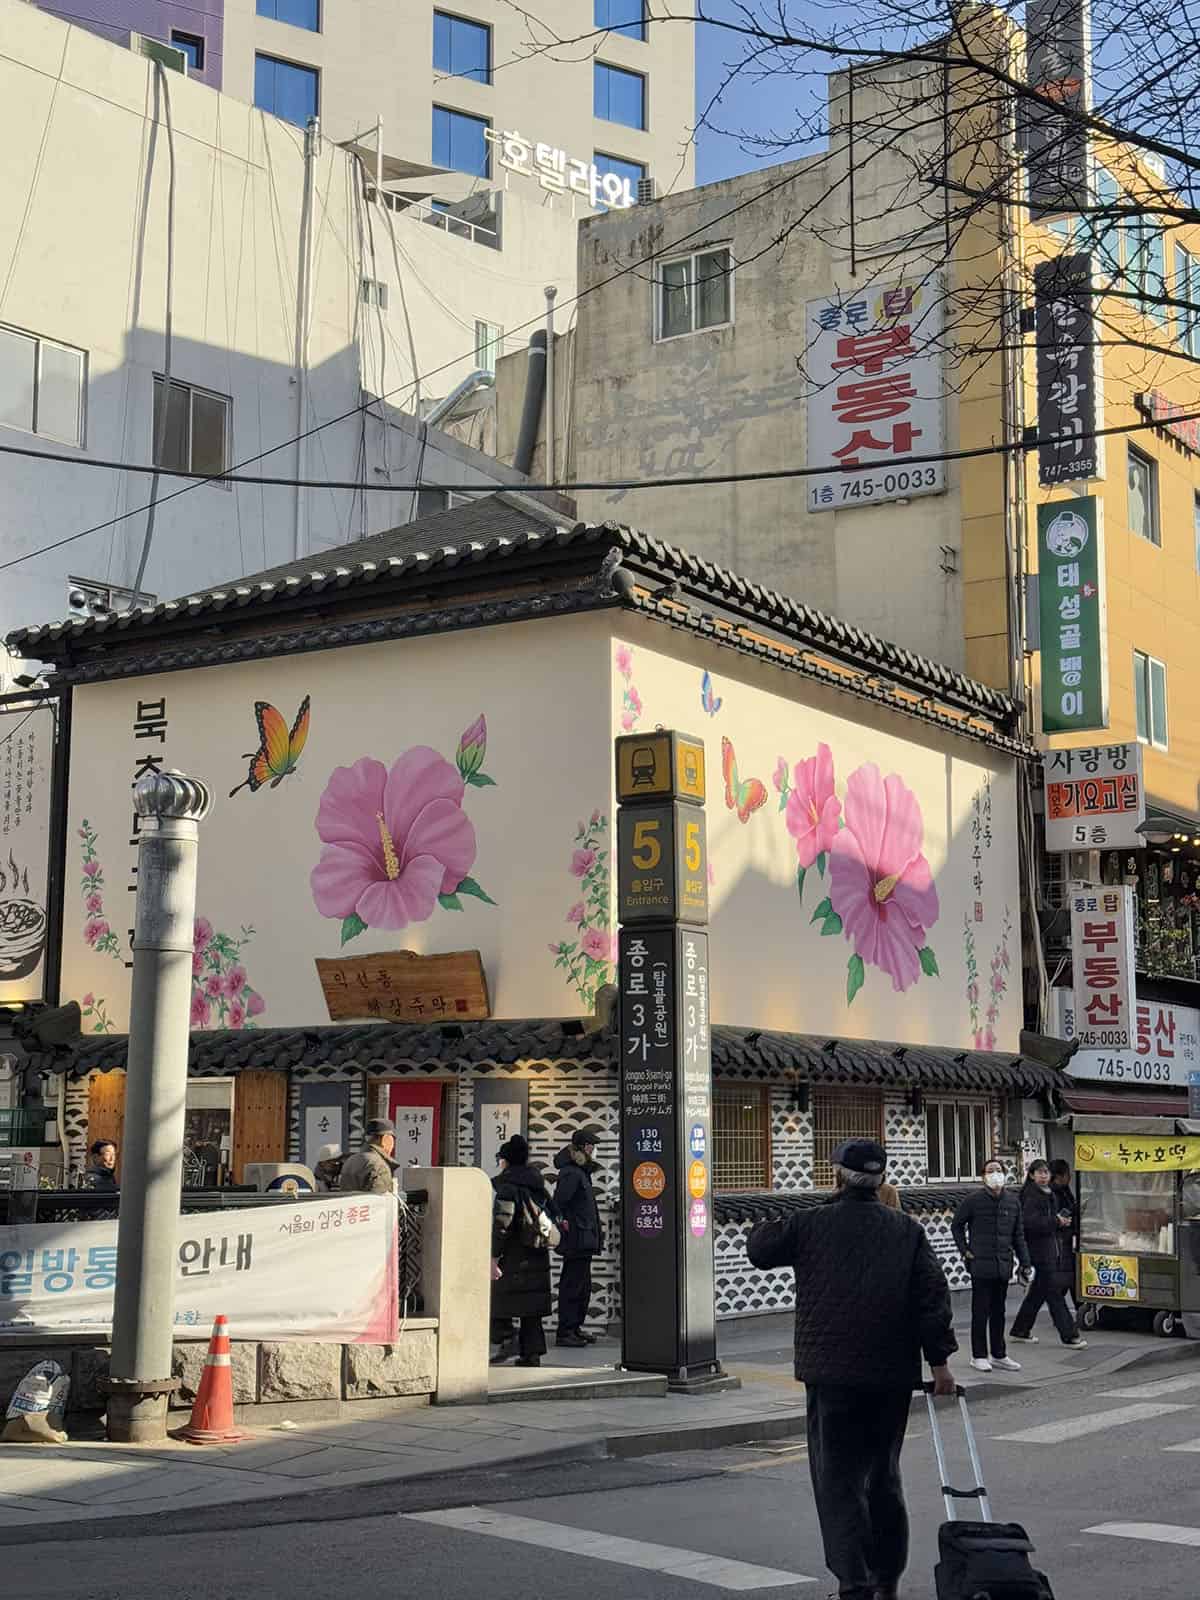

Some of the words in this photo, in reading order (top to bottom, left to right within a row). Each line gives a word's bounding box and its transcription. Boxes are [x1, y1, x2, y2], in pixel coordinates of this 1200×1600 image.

[819, 300, 869, 331] 종로
[830, 324, 923, 474] 부동산
[811, 485, 835, 505] 1층
[840, 467, 937, 500] 745-0033
[1051, 744, 1130, 774] 사랑방
[1063, 776, 1137, 813] 가요교실
[631, 819, 662, 871] 5
[685, 821, 702, 872] 5
[1074, 825, 1108, 844] 5층
[625, 895, 672, 907] Entrance
[1073, 897, 1098, 913] 종로
[1102, 893, 1119, 913] 탑
[1081, 920, 1123, 1026] 부동산
[625, 938, 652, 1062] 종로3가
[684, 941, 700, 1063] 종로3가
[1078, 1030, 1129, 1046] 745-0033
[1096, 1057, 1171, 1082] 745-0033
[635, 1139, 663, 1152] 1호선
[640, 1128, 659, 1139] 130
[1117, 1143, 1187, 1166] 녹차호떡
[279, 1214, 315, 1234] 서울의
[318, 1207, 344, 1230] 심장
[346, 1204, 371, 1225] 종로
[635, 1216, 664, 1229] 5호선
[640, 1205, 659, 1216] 534
[179, 1232, 254, 1278] 안내
